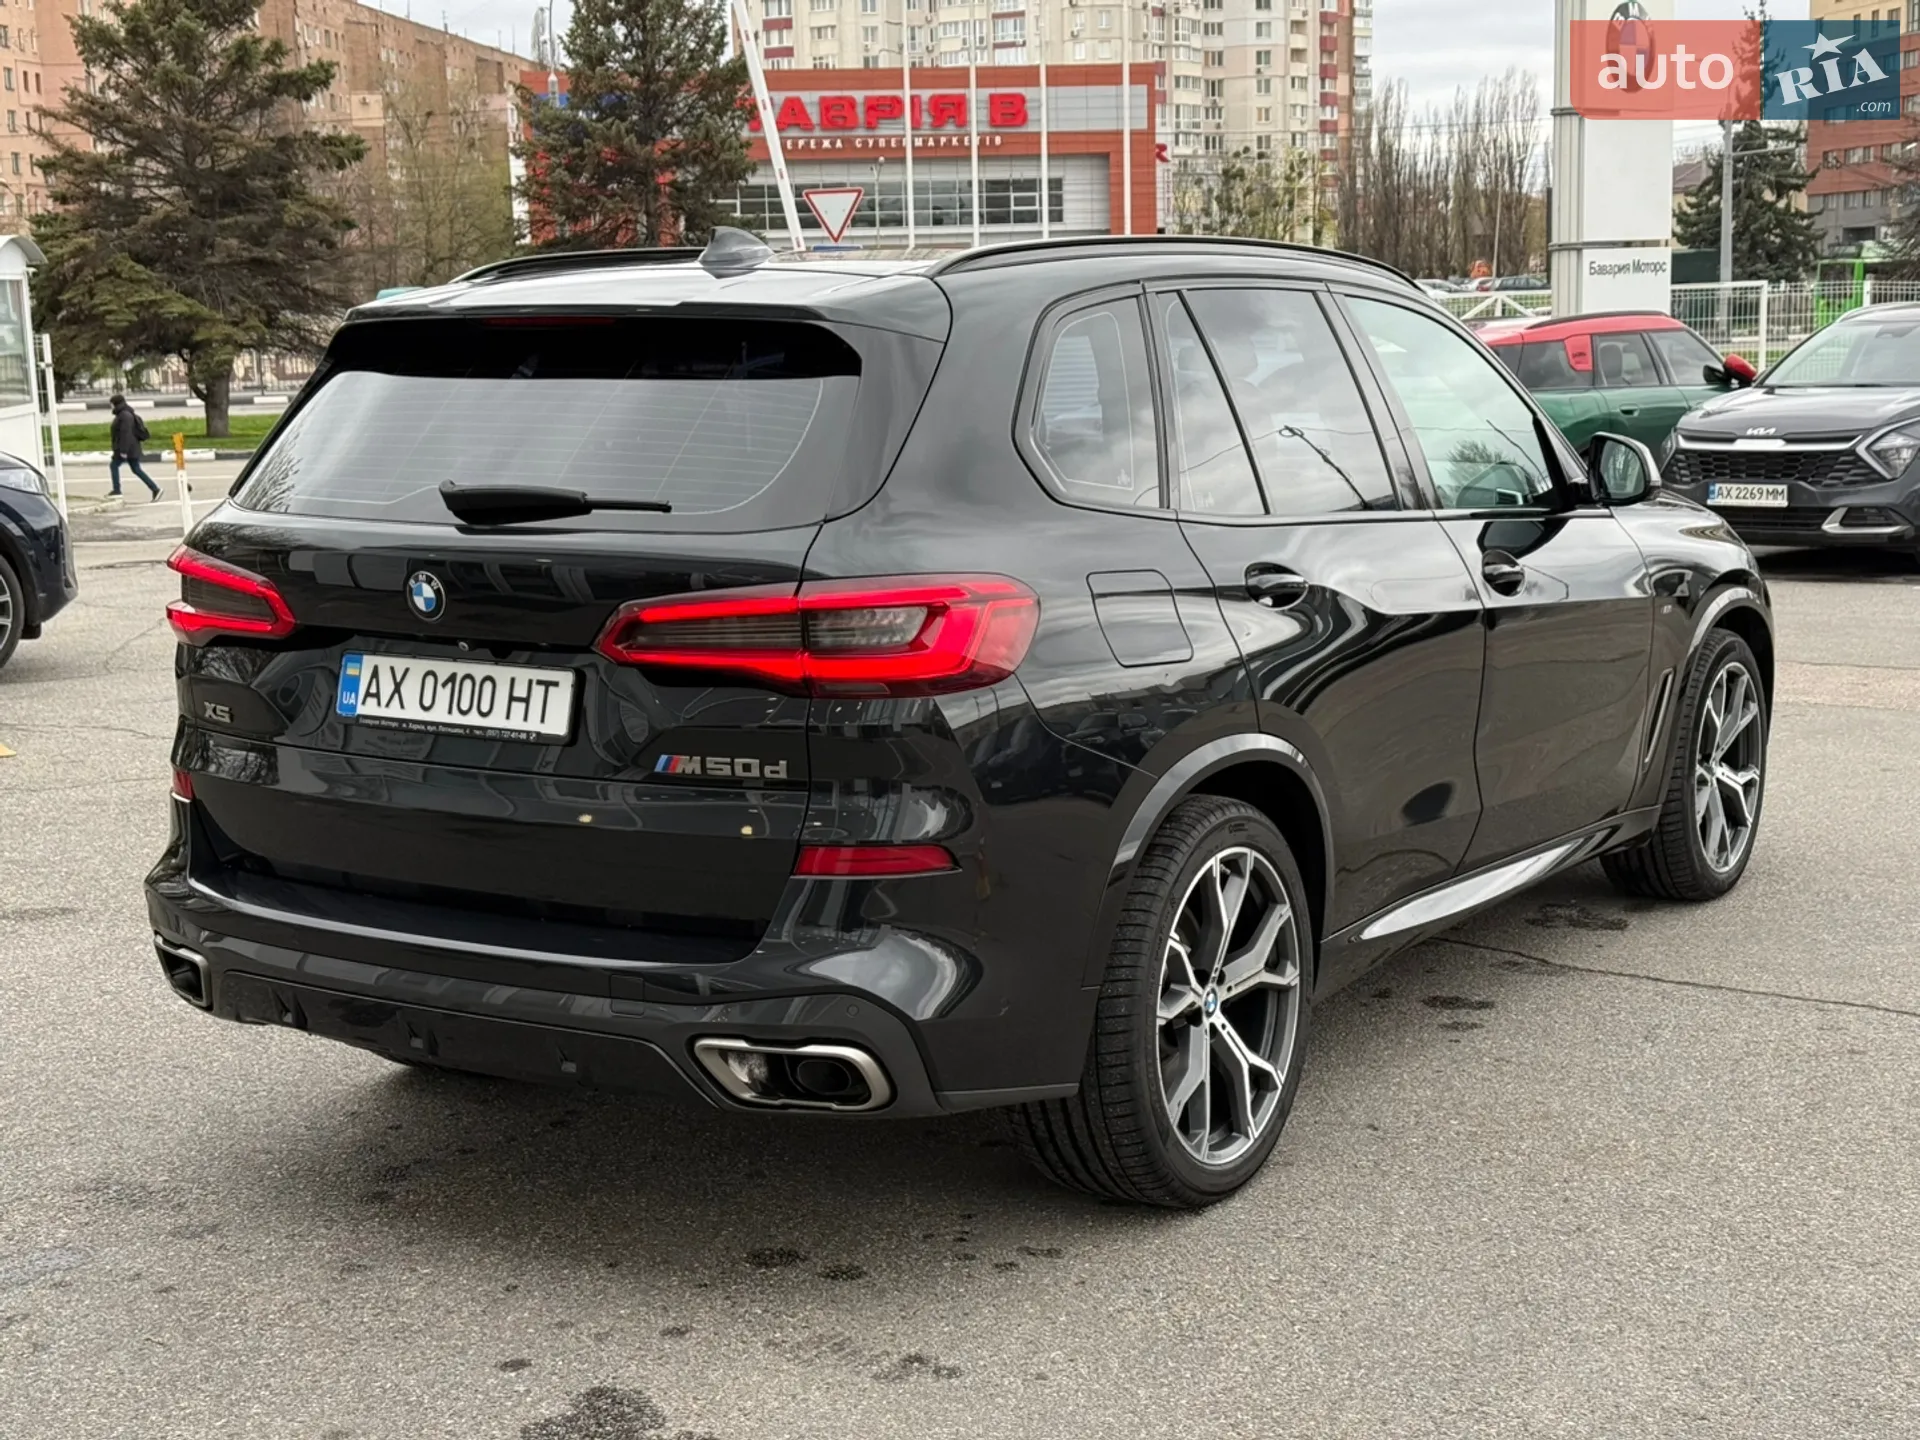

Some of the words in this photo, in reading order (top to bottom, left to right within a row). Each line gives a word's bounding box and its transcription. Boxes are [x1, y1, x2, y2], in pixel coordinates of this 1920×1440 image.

[987, 93, 1027, 128] В
[783, 138, 843, 150] ЕРЕЖА
[1589, 261, 1631, 279] Бавария
[1632, 259, 1667, 276] Моторс
[1717, 486, 1733, 500] AX
[1735, 487, 1764, 501] 2269
[1766, 488, 1785, 501] MM
[342, 691, 356, 705] UA
[361, 664, 410, 710] AX
[419, 669, 497, 718] 0100
[506, 676, 560, 724] HT
[204, 701, 231, 723] X5
[672, 755, 788, 779] M50d
